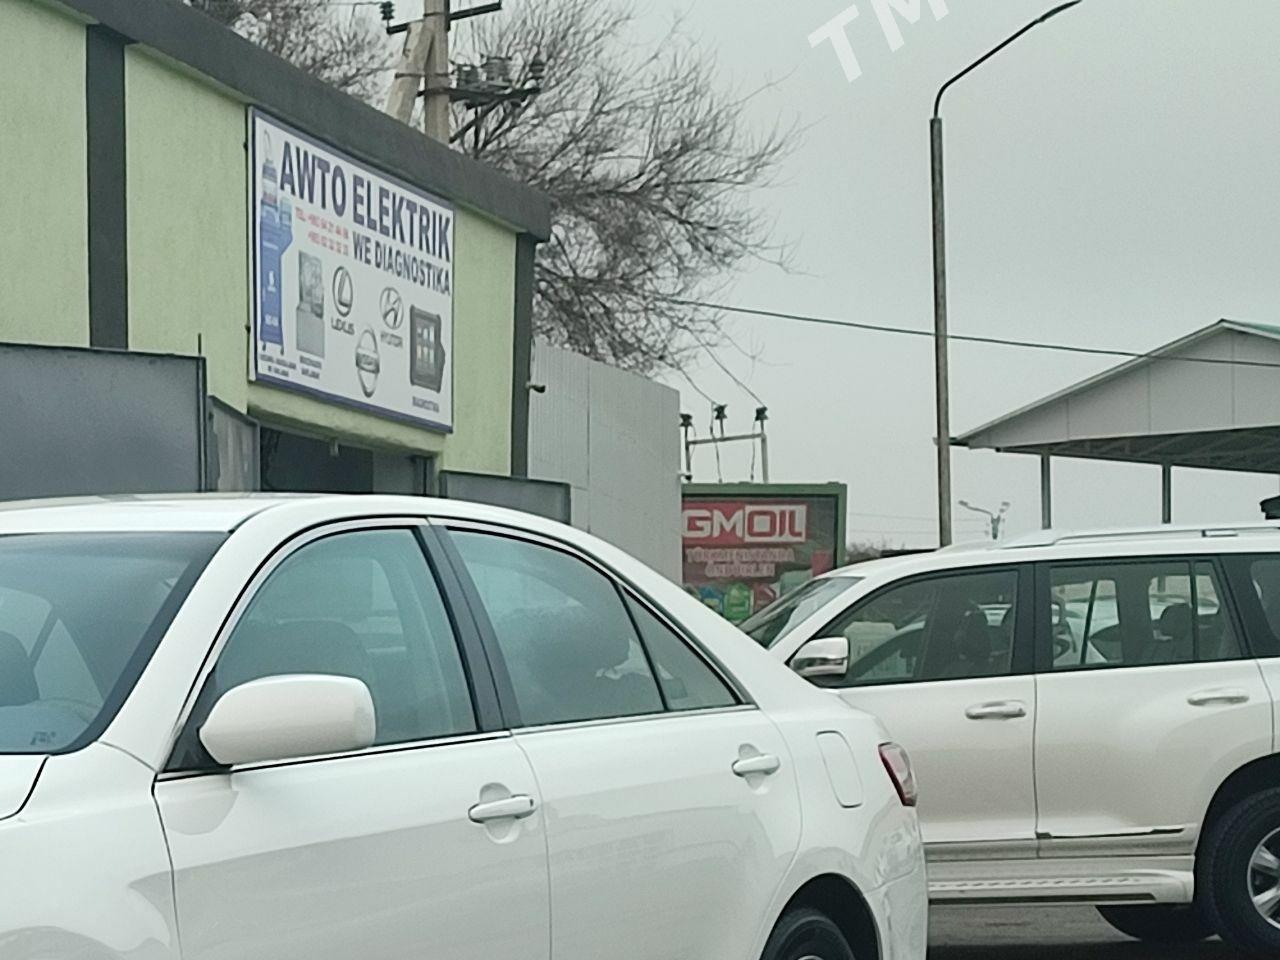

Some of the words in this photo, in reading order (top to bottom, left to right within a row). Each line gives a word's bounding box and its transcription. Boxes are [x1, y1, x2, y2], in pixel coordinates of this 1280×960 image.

[280, 141, 346, 217] AWTO
[352, 174, 451, 263] ELEKTRIK
[352, 230, 372, 265] WE
[375, 240, 451, 296] DIAGNOSTIKA
